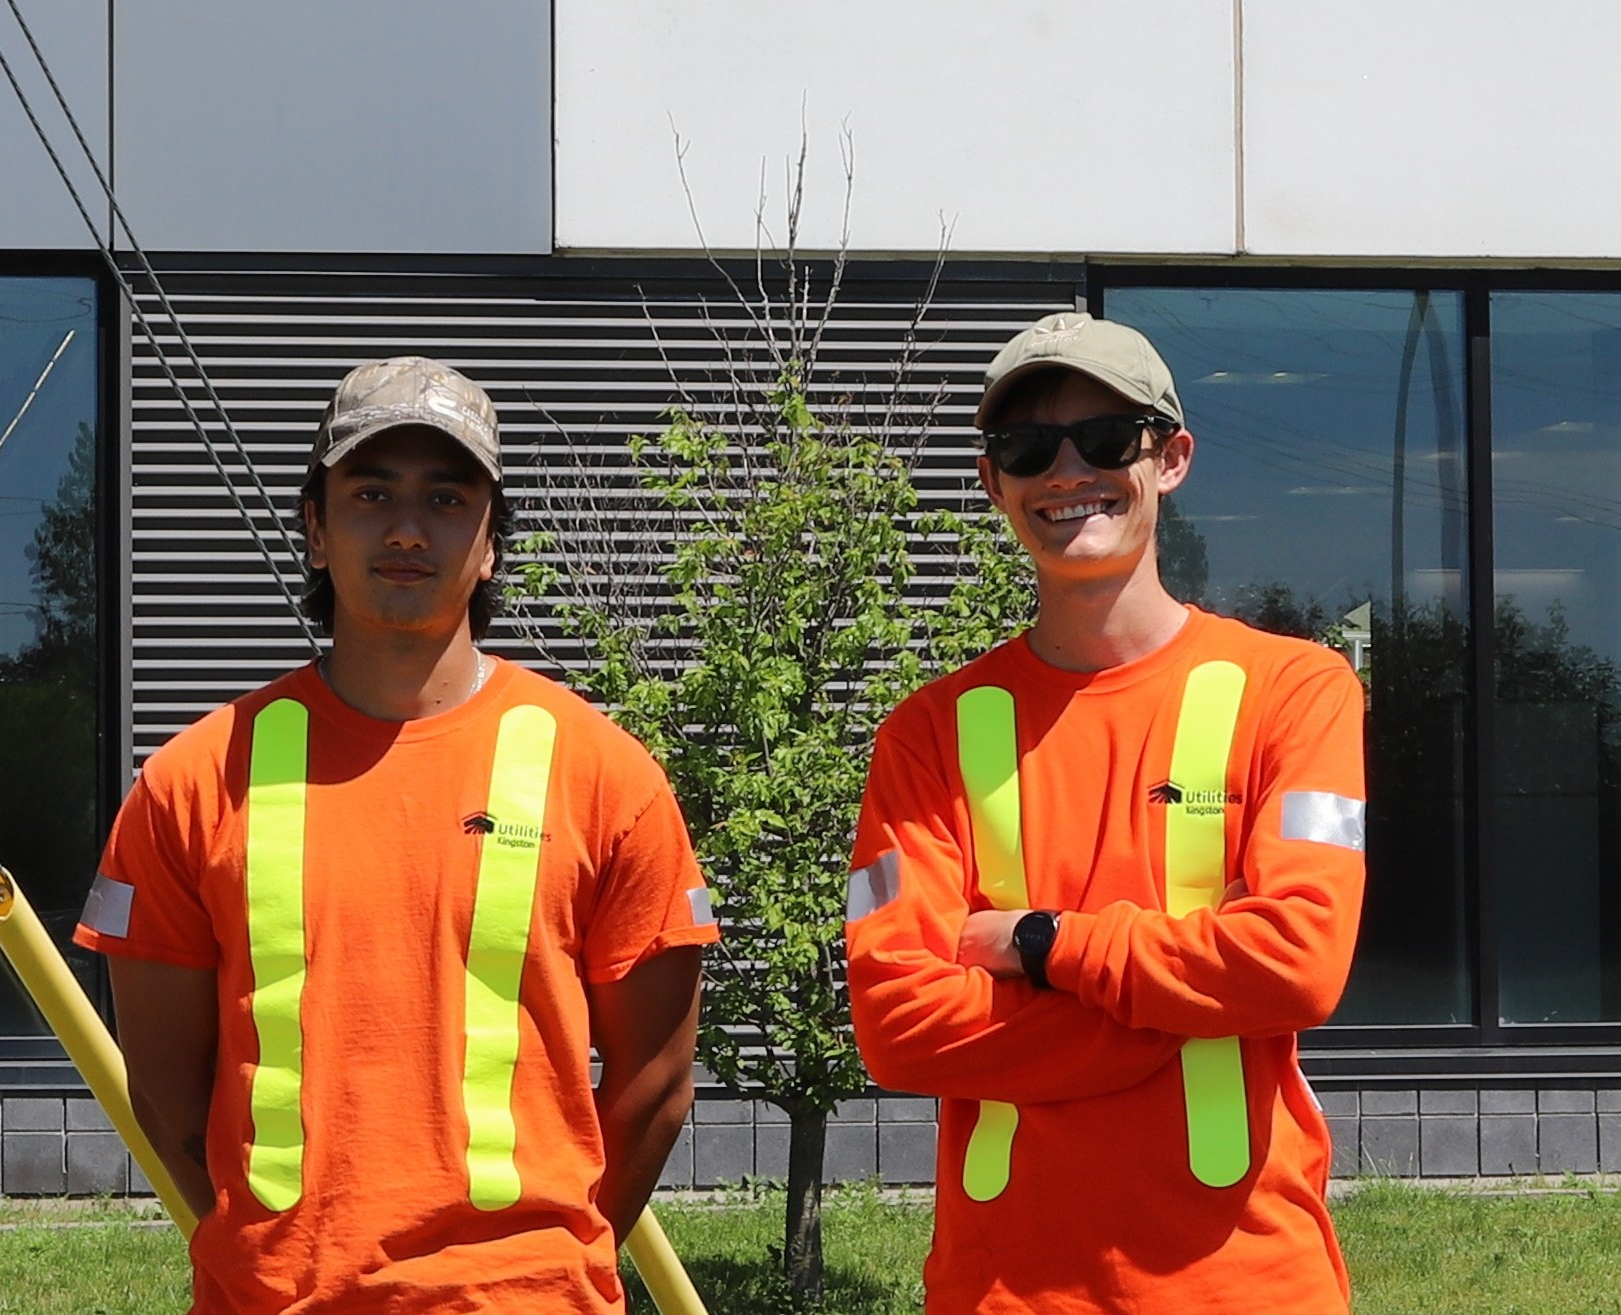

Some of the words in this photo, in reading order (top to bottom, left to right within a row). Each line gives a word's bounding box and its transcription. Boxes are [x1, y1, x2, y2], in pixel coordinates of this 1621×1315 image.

[1185, 790, 1243, 805] Utilities
[1185, 806, 1224, 816] Kingston
[498, 824, 552, 842] Utilities
[497, 837, 536, 848] Kingston
